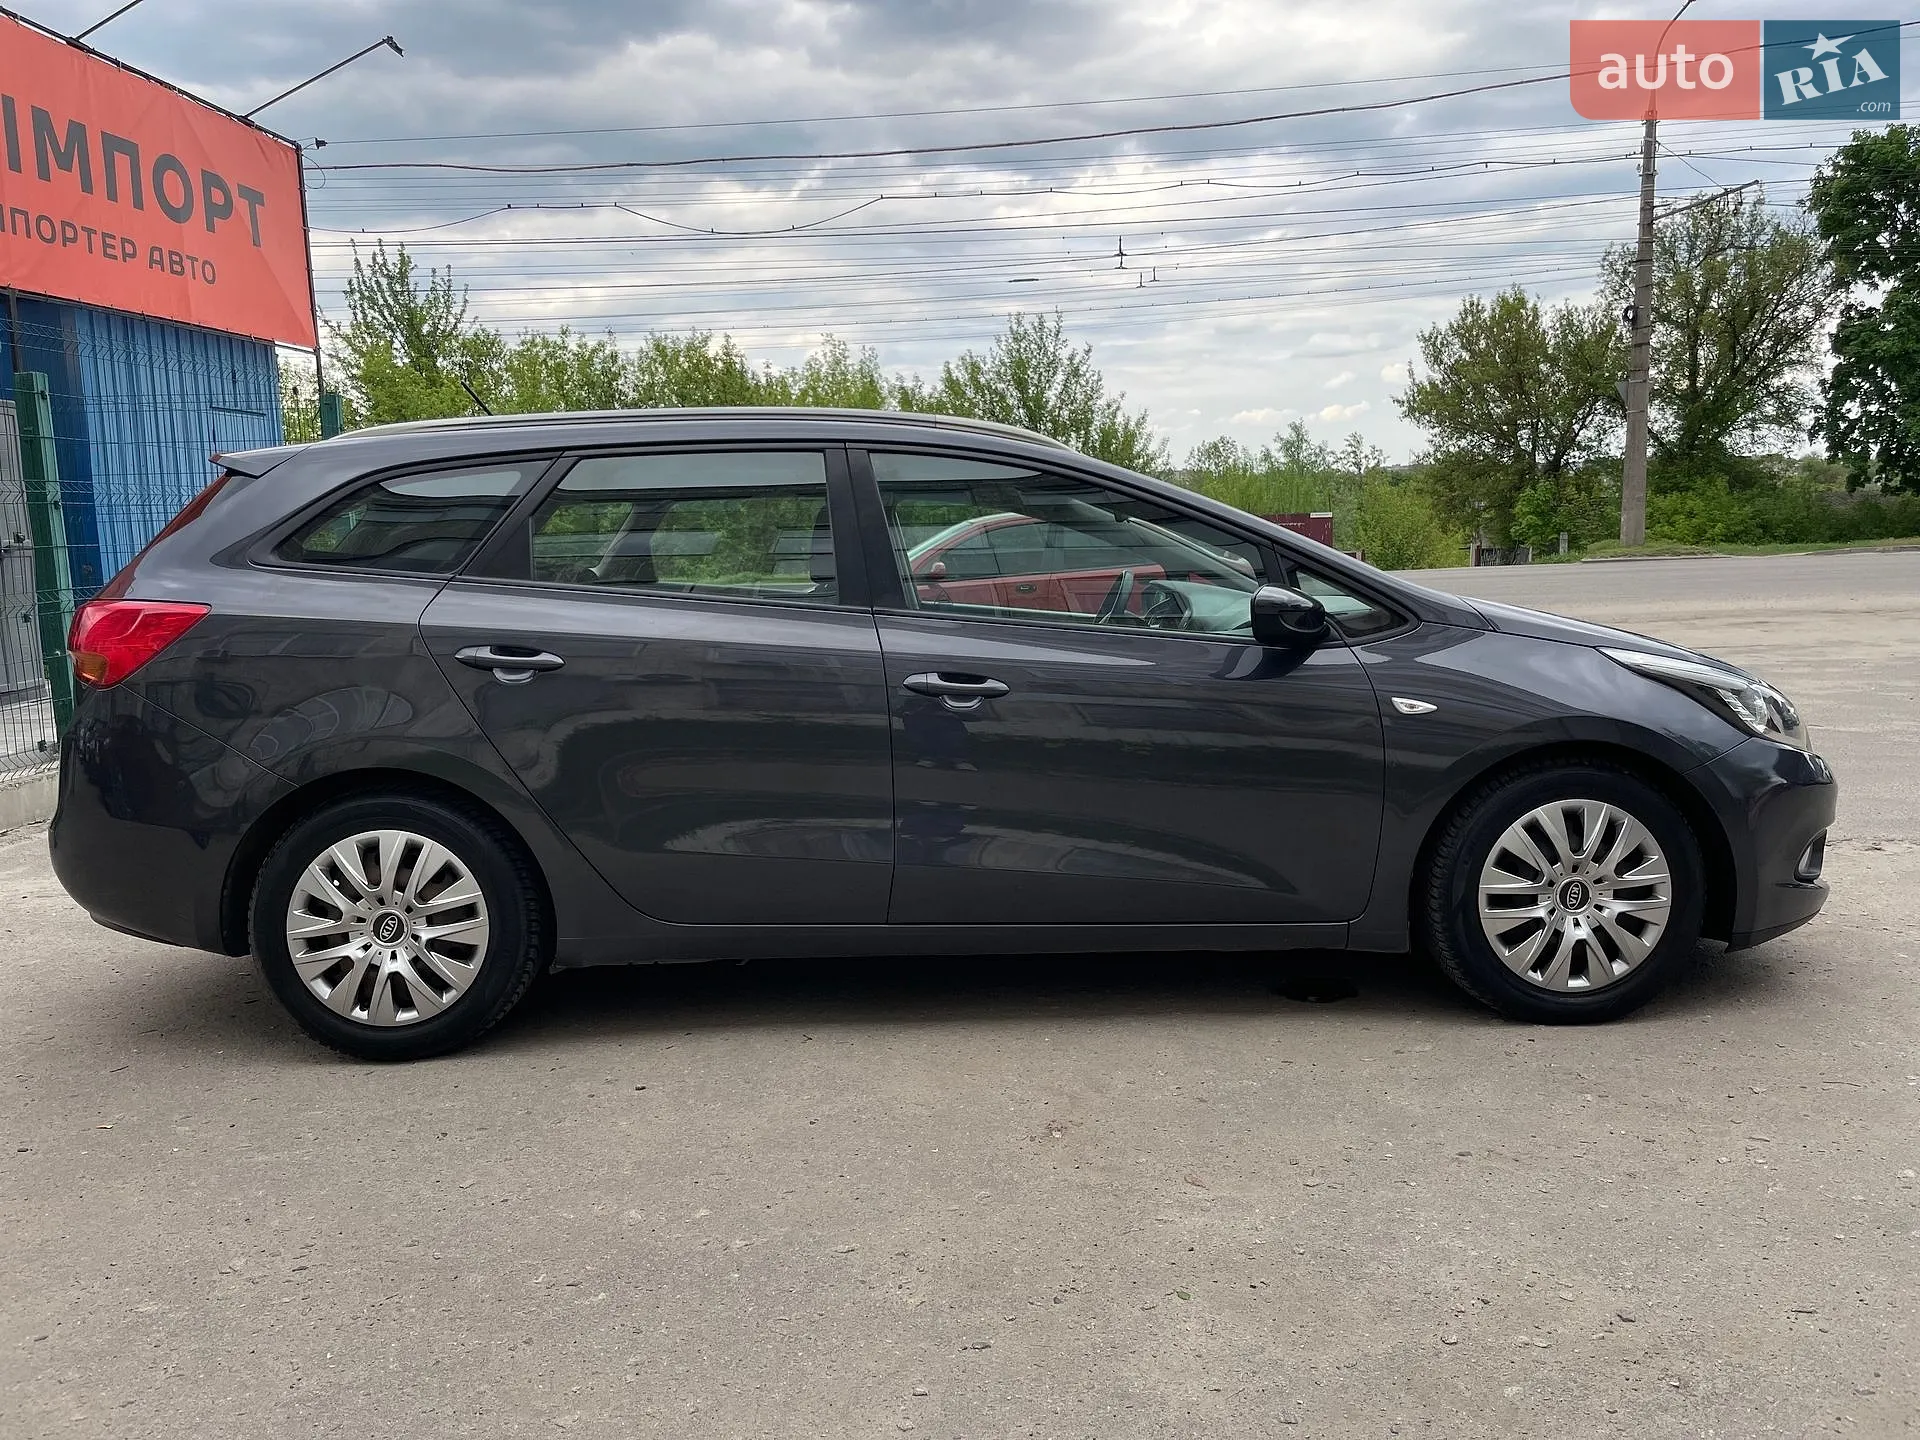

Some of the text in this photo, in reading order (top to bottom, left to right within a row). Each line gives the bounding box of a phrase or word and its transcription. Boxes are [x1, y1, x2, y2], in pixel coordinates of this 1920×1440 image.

[148, 245, 217, 285] АВТО
[1569, 886, 1580, 905] KIA
[381, 919, 396, 938] KIA
